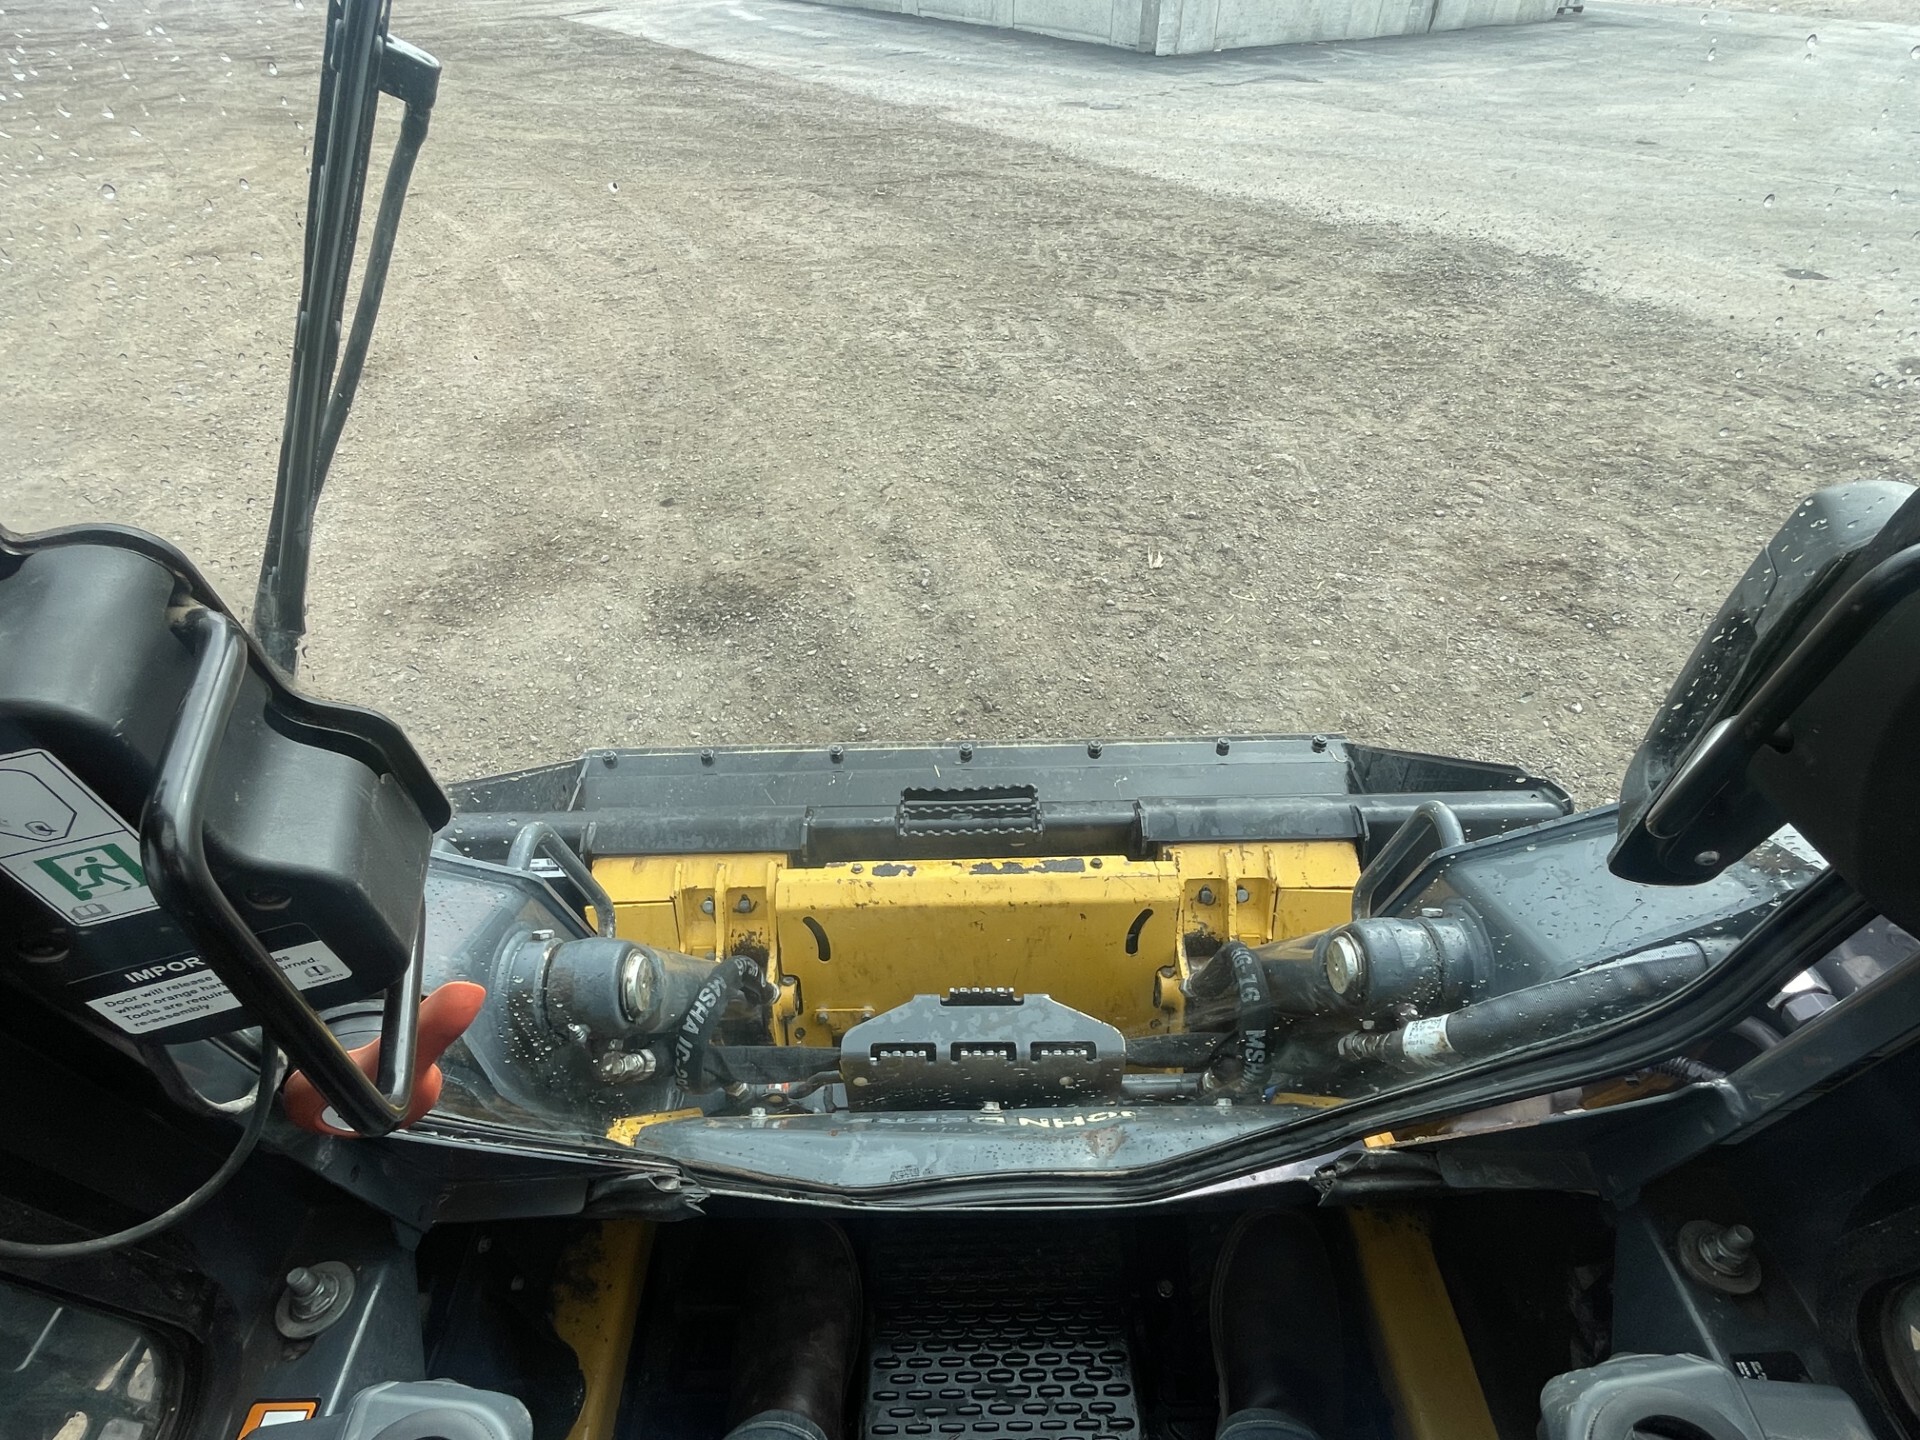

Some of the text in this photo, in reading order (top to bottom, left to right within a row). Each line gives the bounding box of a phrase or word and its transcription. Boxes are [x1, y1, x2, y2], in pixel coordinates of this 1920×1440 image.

[124, 956, 206, 983] IMPOR
[104, 995, 139, 1008] Door
[141, 988, 164, 998] will
[166, 976, 213, 992] release
[115, 957, 320, 1015] when orange han urned.
[123, 989, 231, 1022] Tools are require
[134, 1004, 214, 1028] re-assembly.
[682, 976, 728, 1035] MSHA
